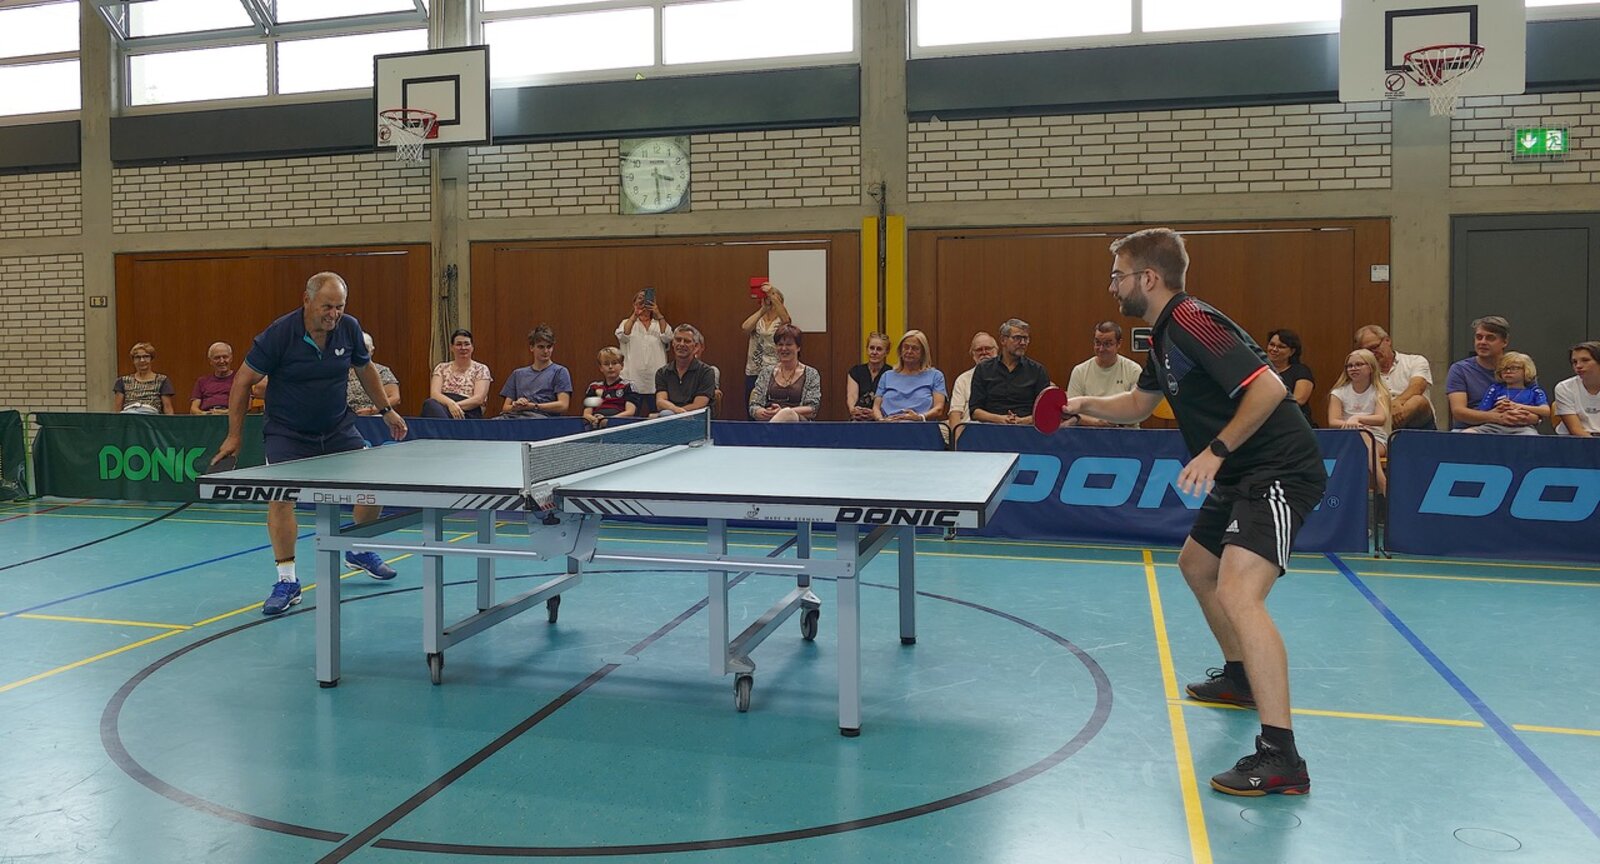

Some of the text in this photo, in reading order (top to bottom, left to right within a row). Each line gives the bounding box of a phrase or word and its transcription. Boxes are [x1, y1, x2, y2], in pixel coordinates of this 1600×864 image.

[642, 150, 648, 158] 11
[653, 145, 661, 154] 12
[675, 157, 681, 166] 2
[680, 170, 686, 179] 3
[633, 185, 639, 195] 8
[642, 194, 648, 203] 7
[98, 444, 207, 482] DONIC
[212, 485, 301, 502] DONIC
[356, 493, 376, 505] 25
[835, 507, 960, 527] DONIC
